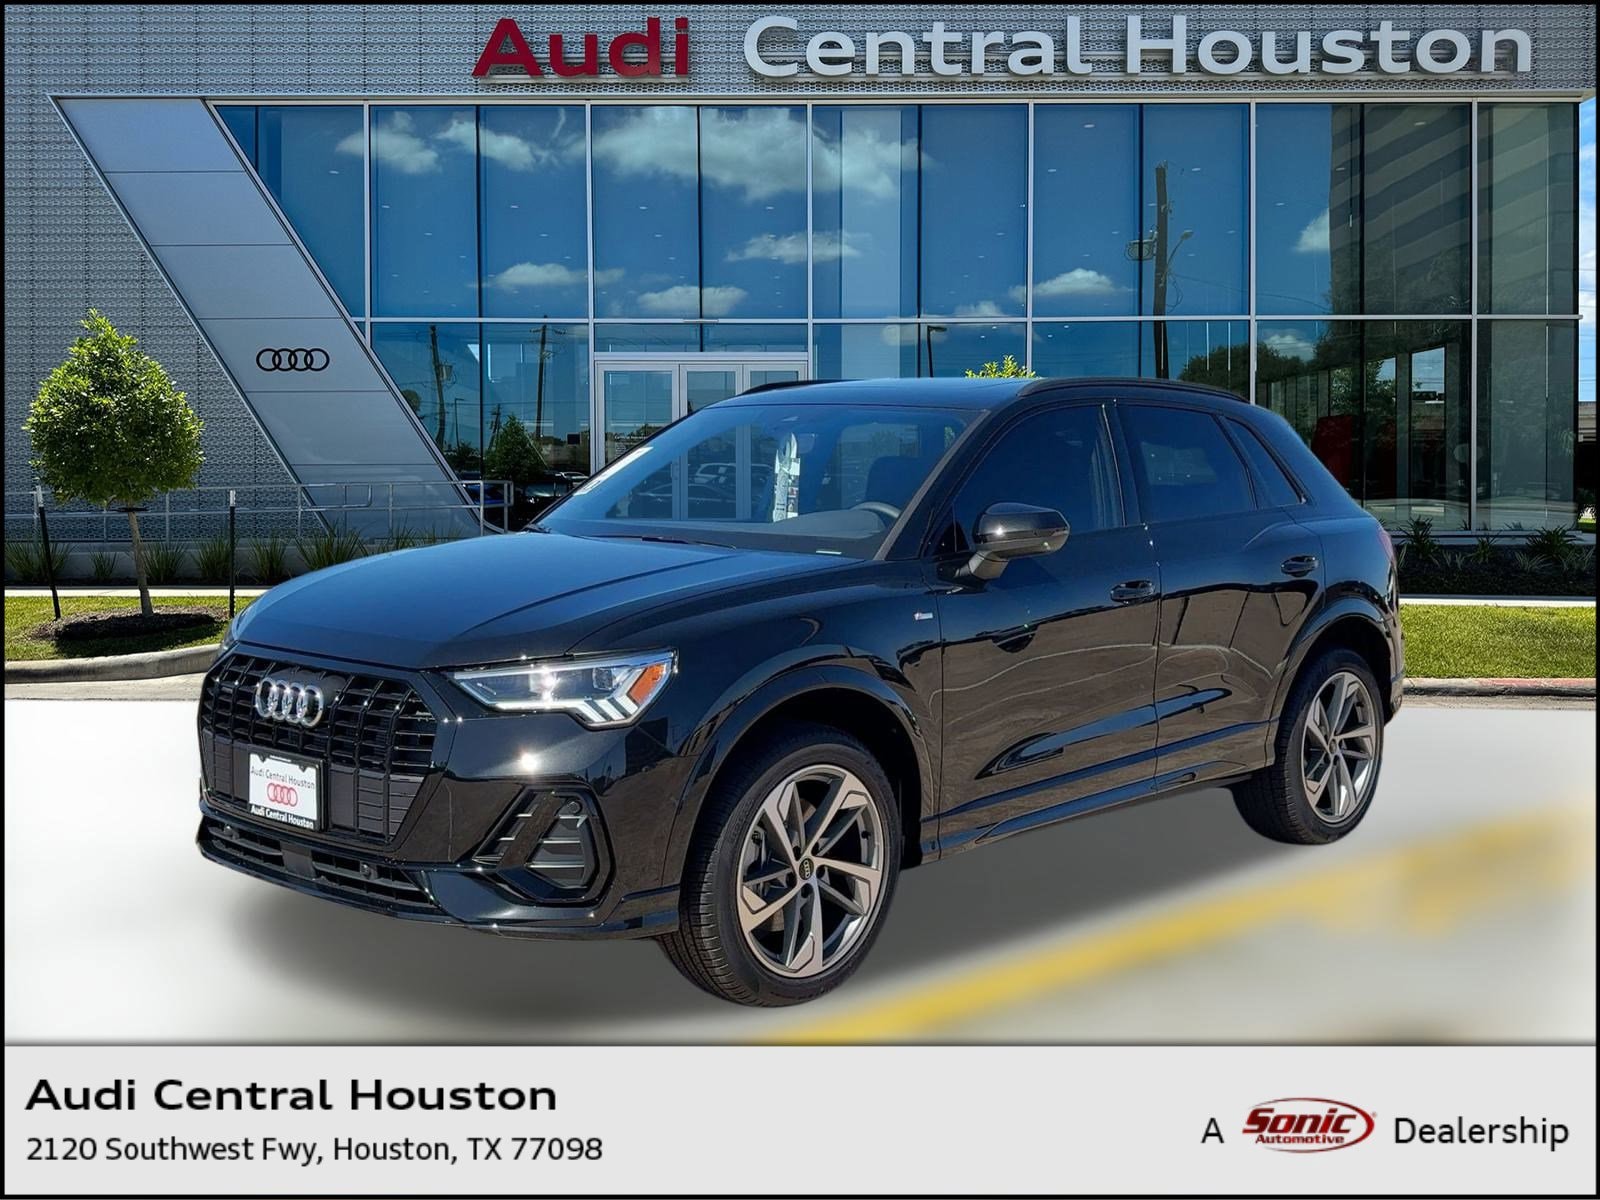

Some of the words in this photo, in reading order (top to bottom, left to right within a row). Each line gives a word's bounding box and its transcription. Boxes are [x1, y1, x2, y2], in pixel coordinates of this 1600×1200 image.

[472, 16, 688, 77] Audi
[744, 16, 1094, 77] Central
[1126, 15, 1531, 76] Houston
[250, 765, 265, 778] Audi
[265, 769, 288, 783] Central
[288, 774, 315, 789] Houston
[250, 805, 265, 817] Audi
[265, 808, 288, 823] Central
[288, 813, 314, 830] Houston
